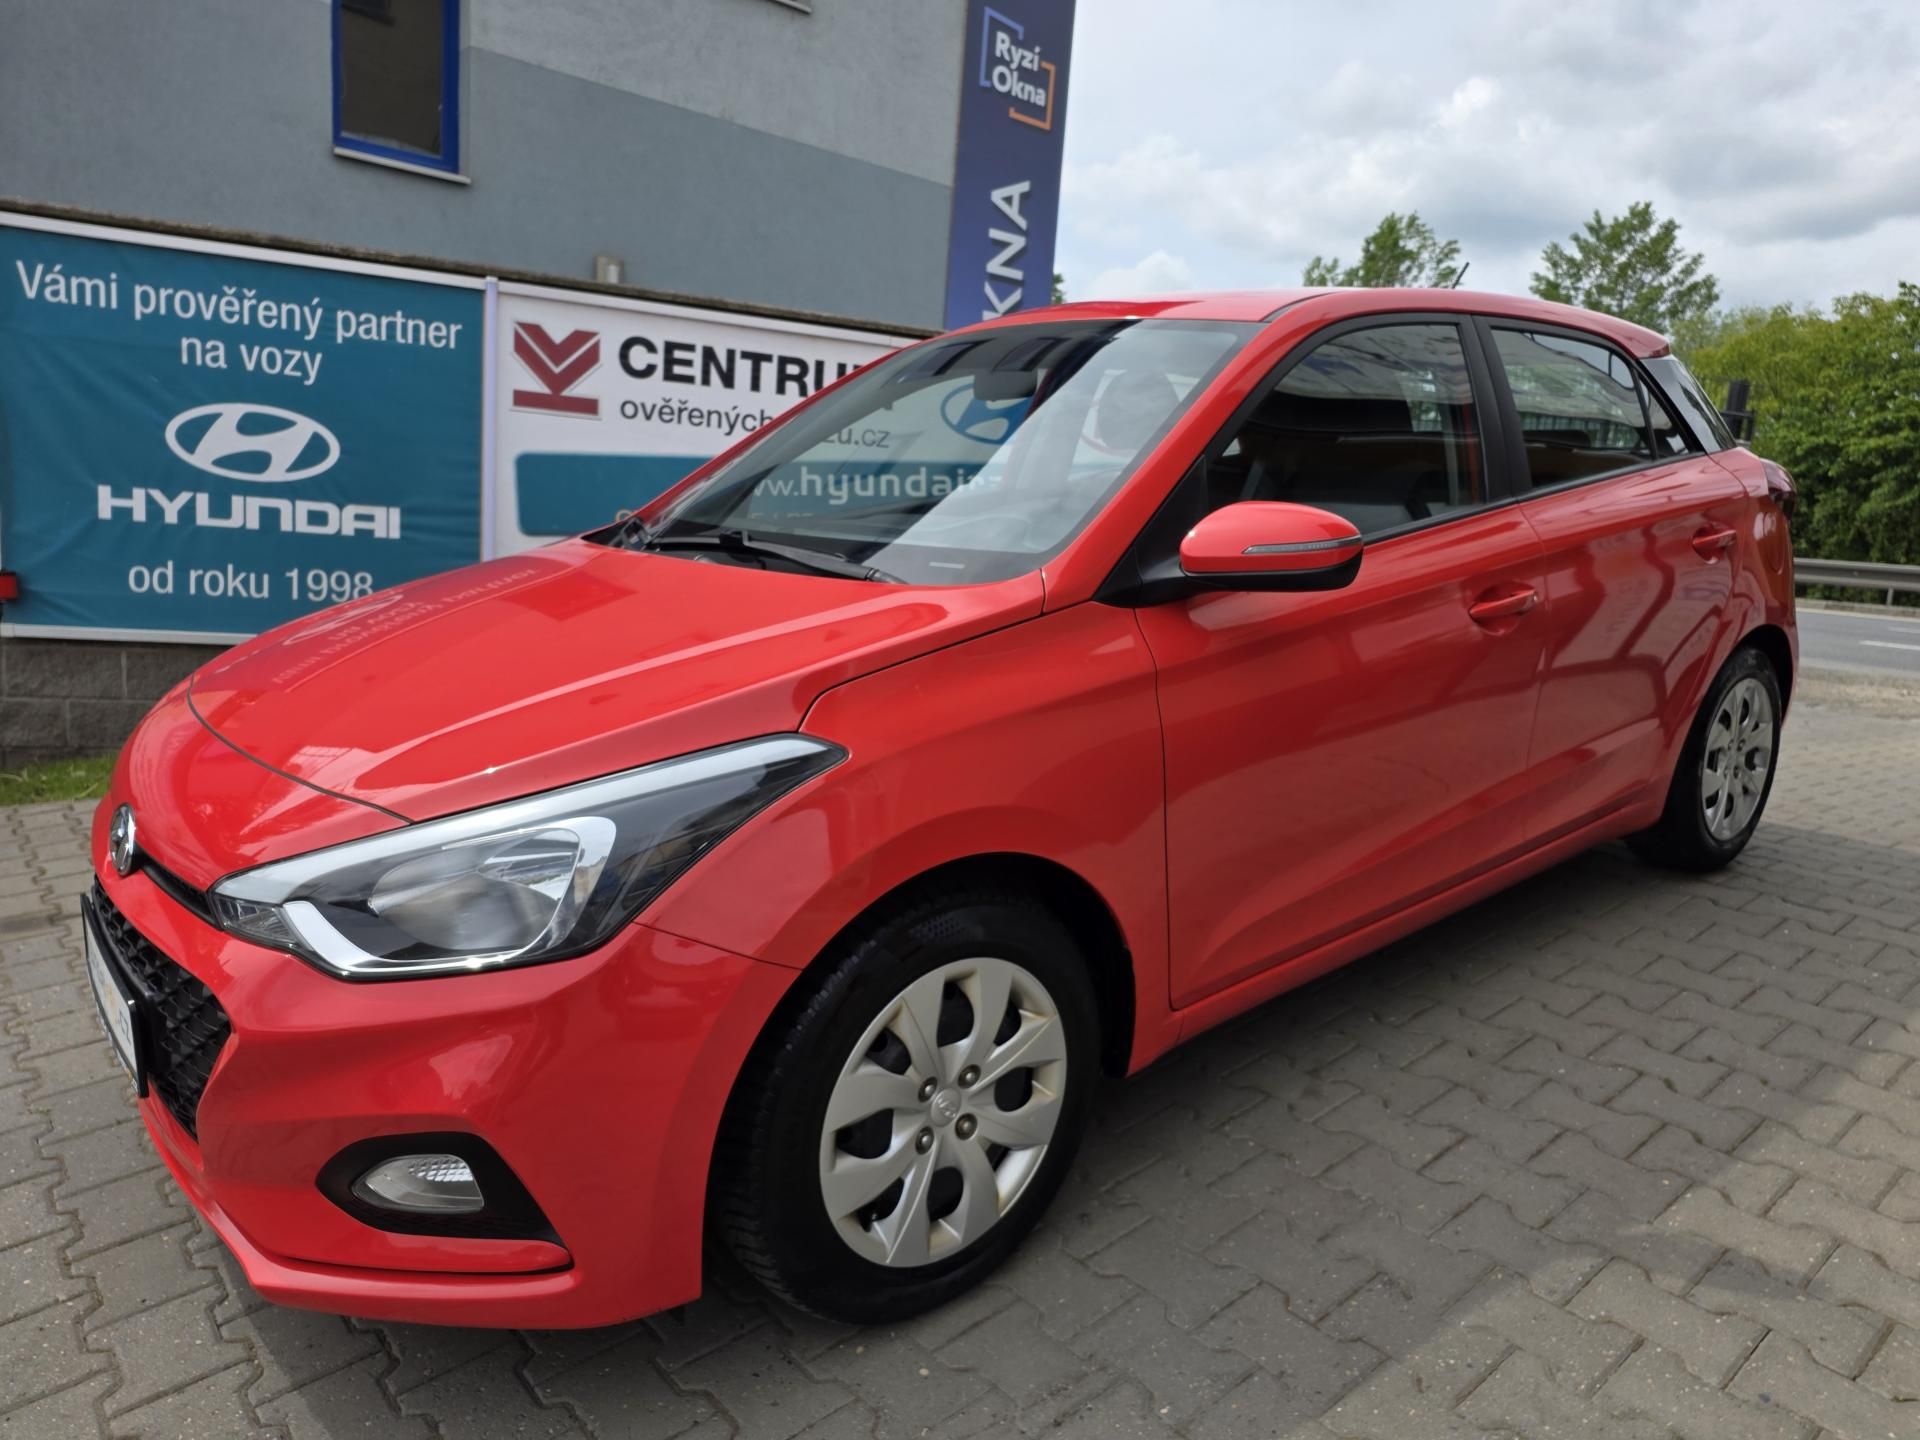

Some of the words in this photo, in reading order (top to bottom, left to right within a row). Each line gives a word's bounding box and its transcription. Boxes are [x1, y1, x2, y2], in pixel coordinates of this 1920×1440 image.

[992, 65, 1047, 108] Okna
[982, 180, 1031, 322] KNA
[16, 260, 119, 311] Vámi
[133, 284, 324, 341] prověřený
[336, 309, 463, 350] partner
[180, 337, 227, 369] na
[239, 344, 323, 386] vozy
[619, 336, 867, 399] CENTRU
[97, 484, 400, 539] HYUNDAI
[128, 560, 175, 595] od
[189, 563, 271, 600] roku
[284, 568, 373, 601] 1998
